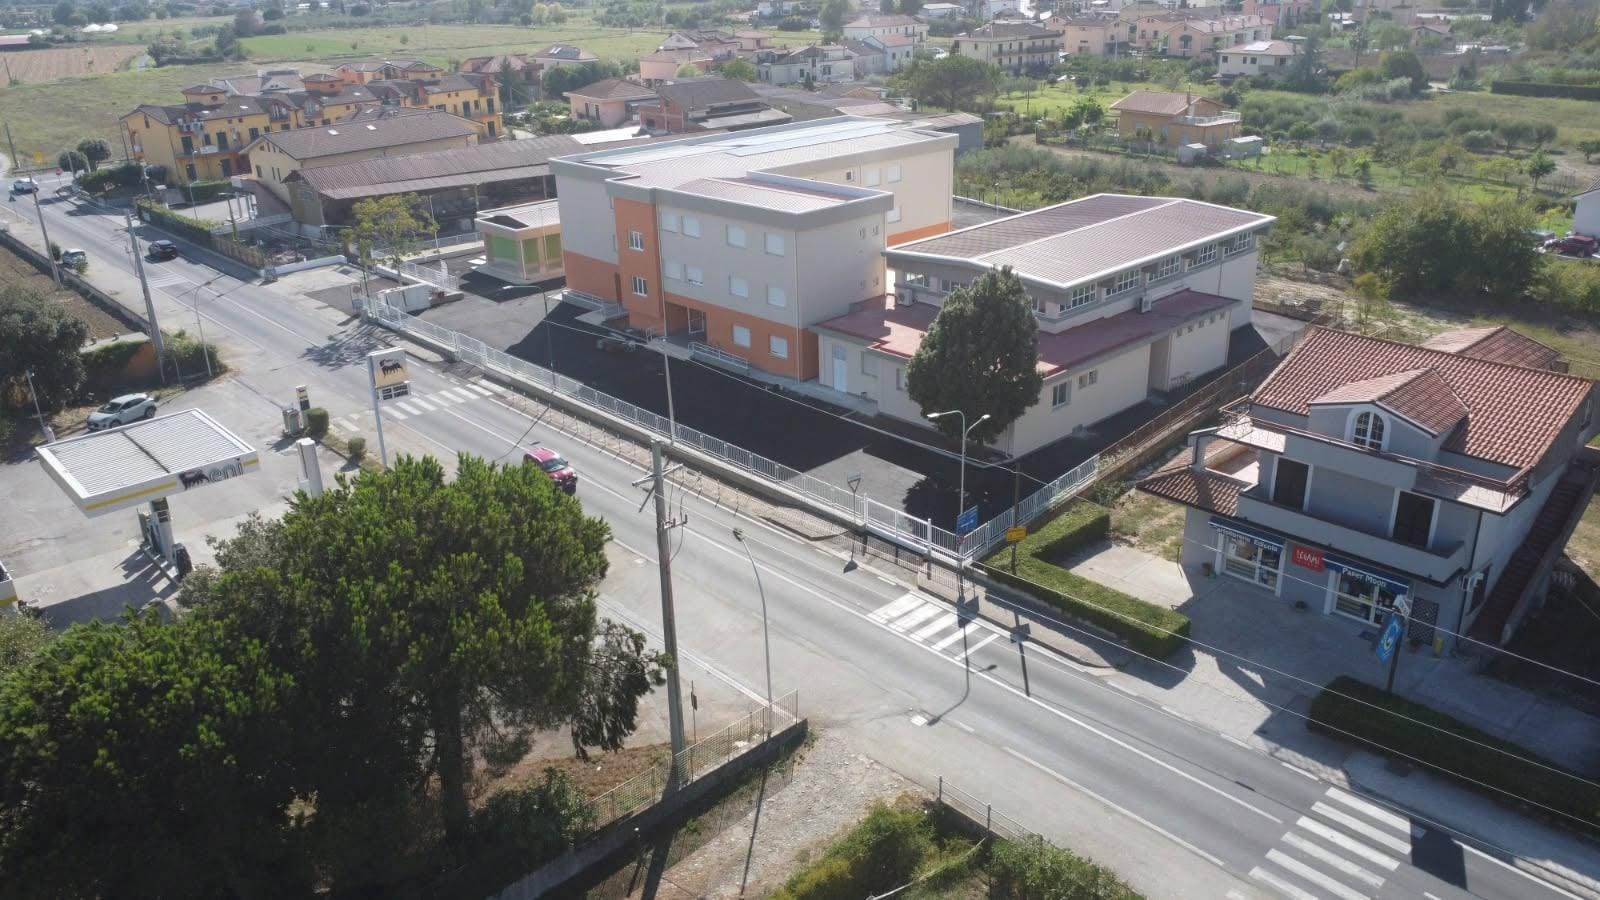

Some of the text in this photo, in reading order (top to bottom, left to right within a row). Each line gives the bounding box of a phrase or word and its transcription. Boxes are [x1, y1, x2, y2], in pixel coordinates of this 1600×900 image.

[210, 457, 243, 482] eni
[1341, 567, 1387, 588] Paper Moon
